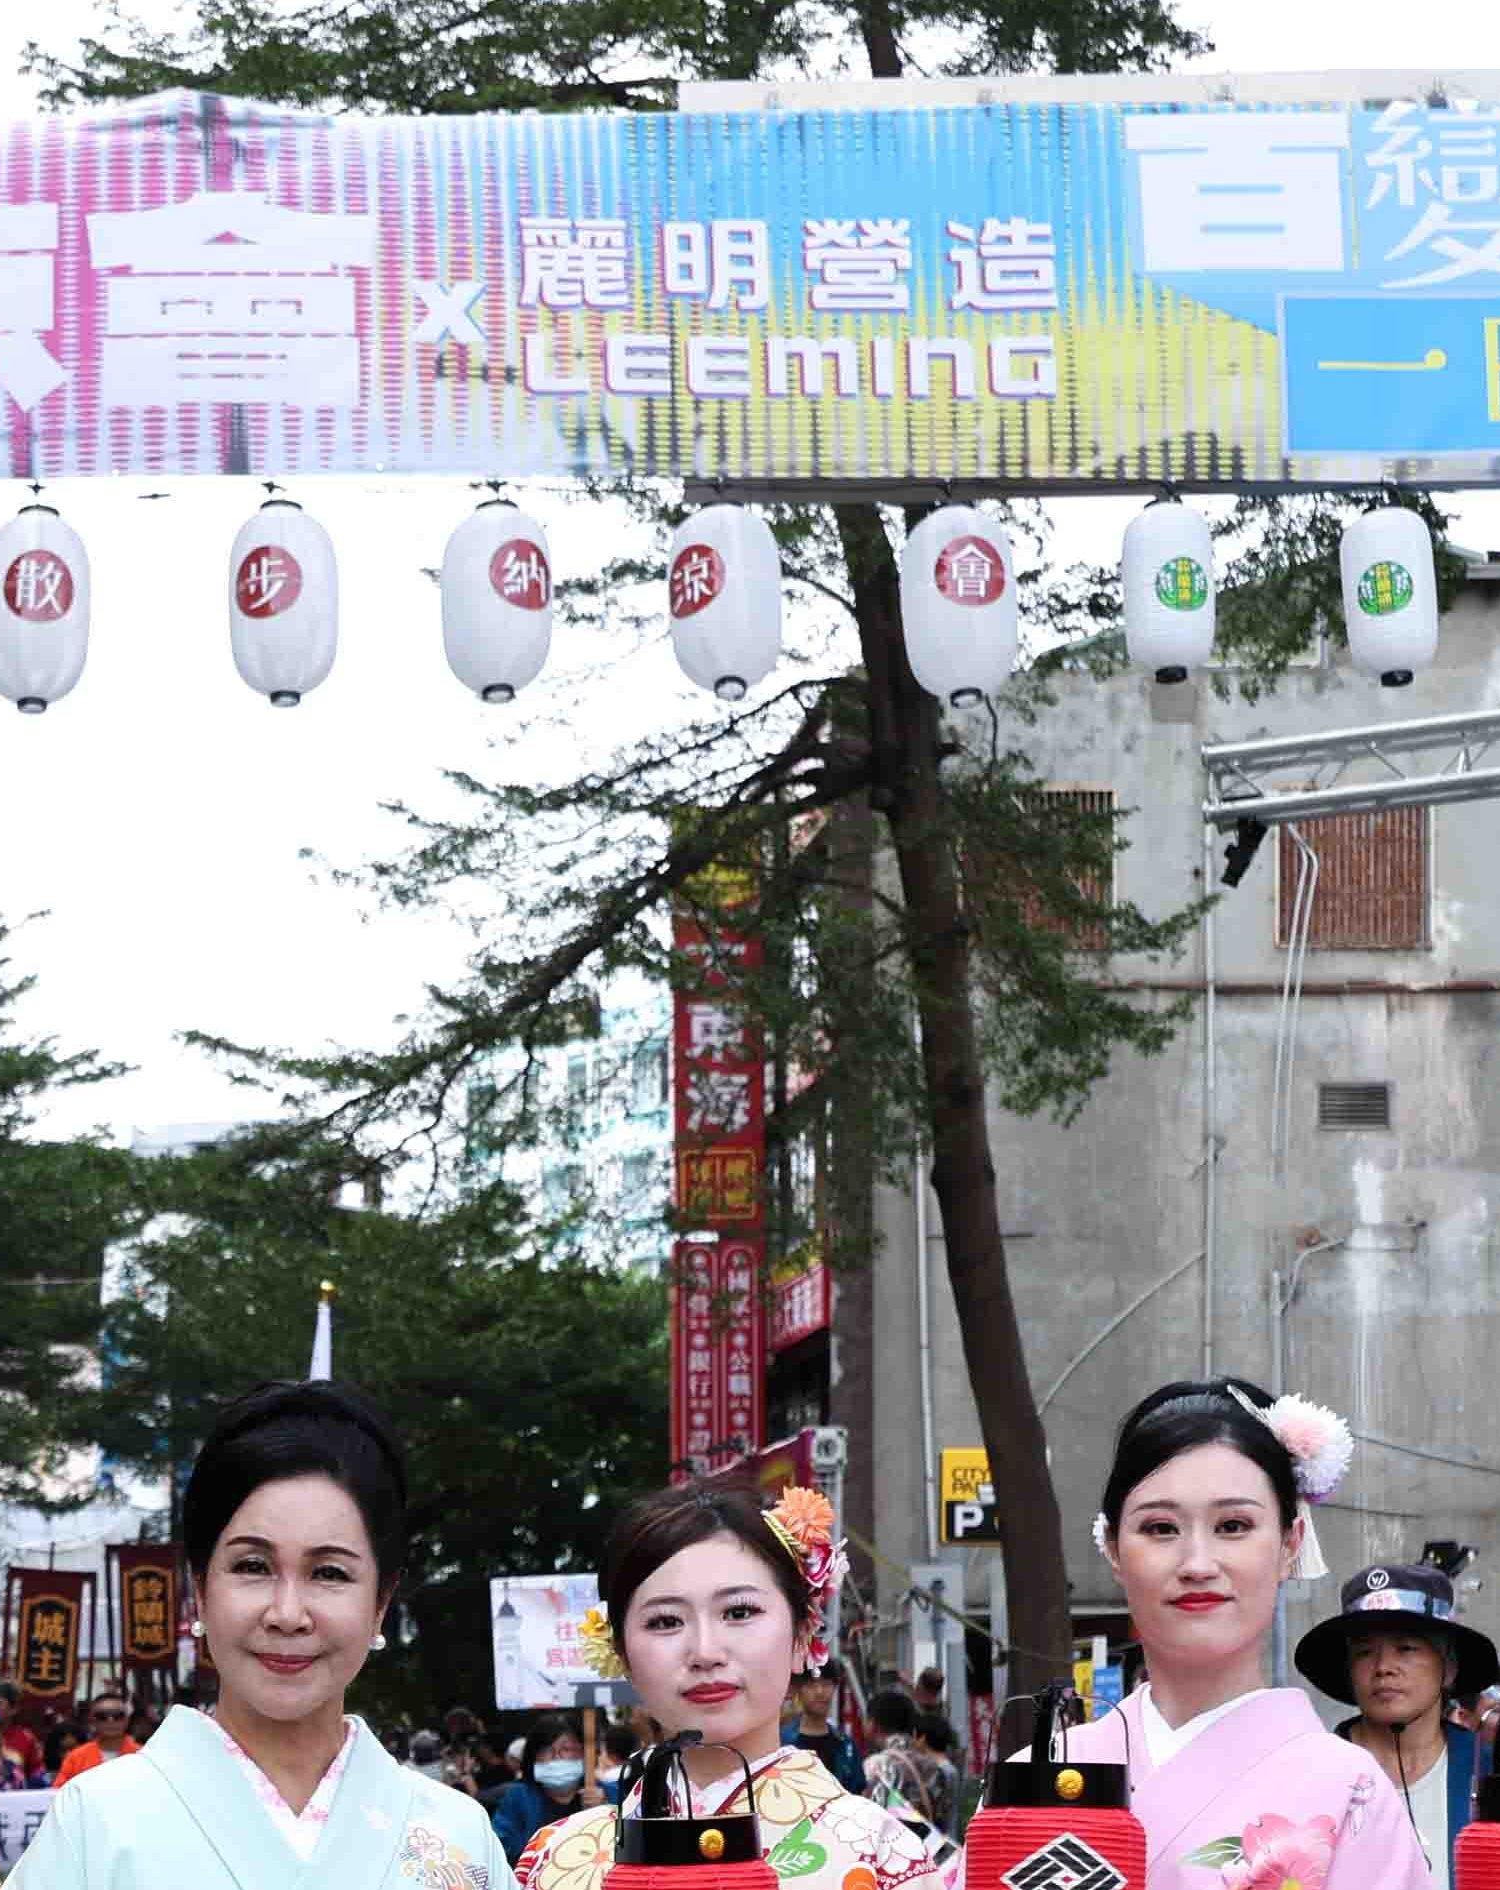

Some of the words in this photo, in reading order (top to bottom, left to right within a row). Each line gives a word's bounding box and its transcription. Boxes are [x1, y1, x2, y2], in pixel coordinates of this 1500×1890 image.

[519, 215, 1056, 315] 麗明營造
[16, 560, 64, 614] 散
[248, 557, 288, 610] 步
[504, 550, 548, 601] 納
[672, 551, 714, 608] 涼
[950, 544, 993, 598] 會
[952, 1468, 990, 1482] CITY
[954, 1503, 984, 1538] P
[31, 1611, 66, 1681] 城主
